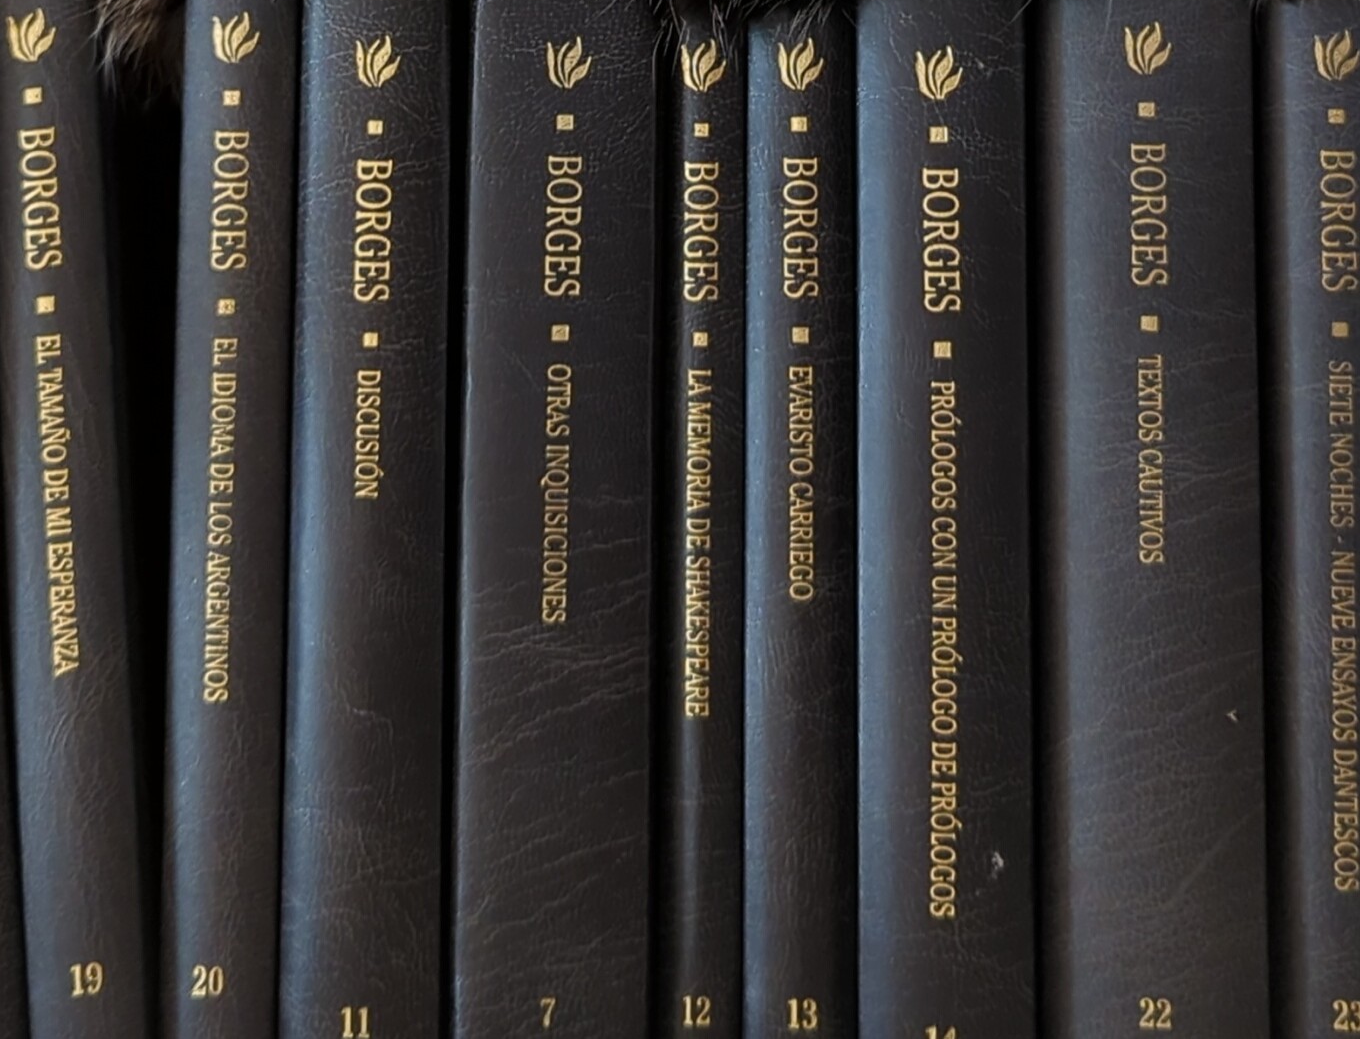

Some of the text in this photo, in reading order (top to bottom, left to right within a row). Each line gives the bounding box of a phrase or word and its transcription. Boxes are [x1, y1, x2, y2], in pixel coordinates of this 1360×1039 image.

[1319, 149, 1359, 292] BORGES
[353, 158, 394, 498] BORGES DISCUSIÓN
[782, 157, 819, 601] BORGES EVARISTO CARRIEGO
[1130, 142, 1169, 564] BORGES TEXTOS CAUTIVOS
[18, 126, 79, 678] BORGES EL TAMAÑO DE MI ESPERANZA
[202, 130, 250, 703] BORGES EL IDIOMA DE LOS ARGENTINOS
[540, 155, 583, 625] BORGES OTRAS INQUISICIONES
[682, 160, 720, 720] BORGES LA MEMORIA DE SHAKESPEARE
[1328, 361, 1354, 427] SIETE
[1328, 433, 1355, 528] NOCHES
[922, 167, 964, 918] BORGES PRÓLOGOS CON UN PRÓLOGO DE PRÓLOGOS
[1330, 550, 1356, 631] NUEVE
[1331, 636, 1359, 743] ENSAYOS
[1332, 748, 1360, 892] DANTESCOS
[70, 962, 103, 997] 19
[191, 964, 224, 998] 20
[341, 1006, 370, 1039] 11
[539, 997, 556, 1029] 7
[682, 995, 711, 1027] 12
[787, 998, 818, 1030] 13
[1138, 996, 1172, 1030] 22
